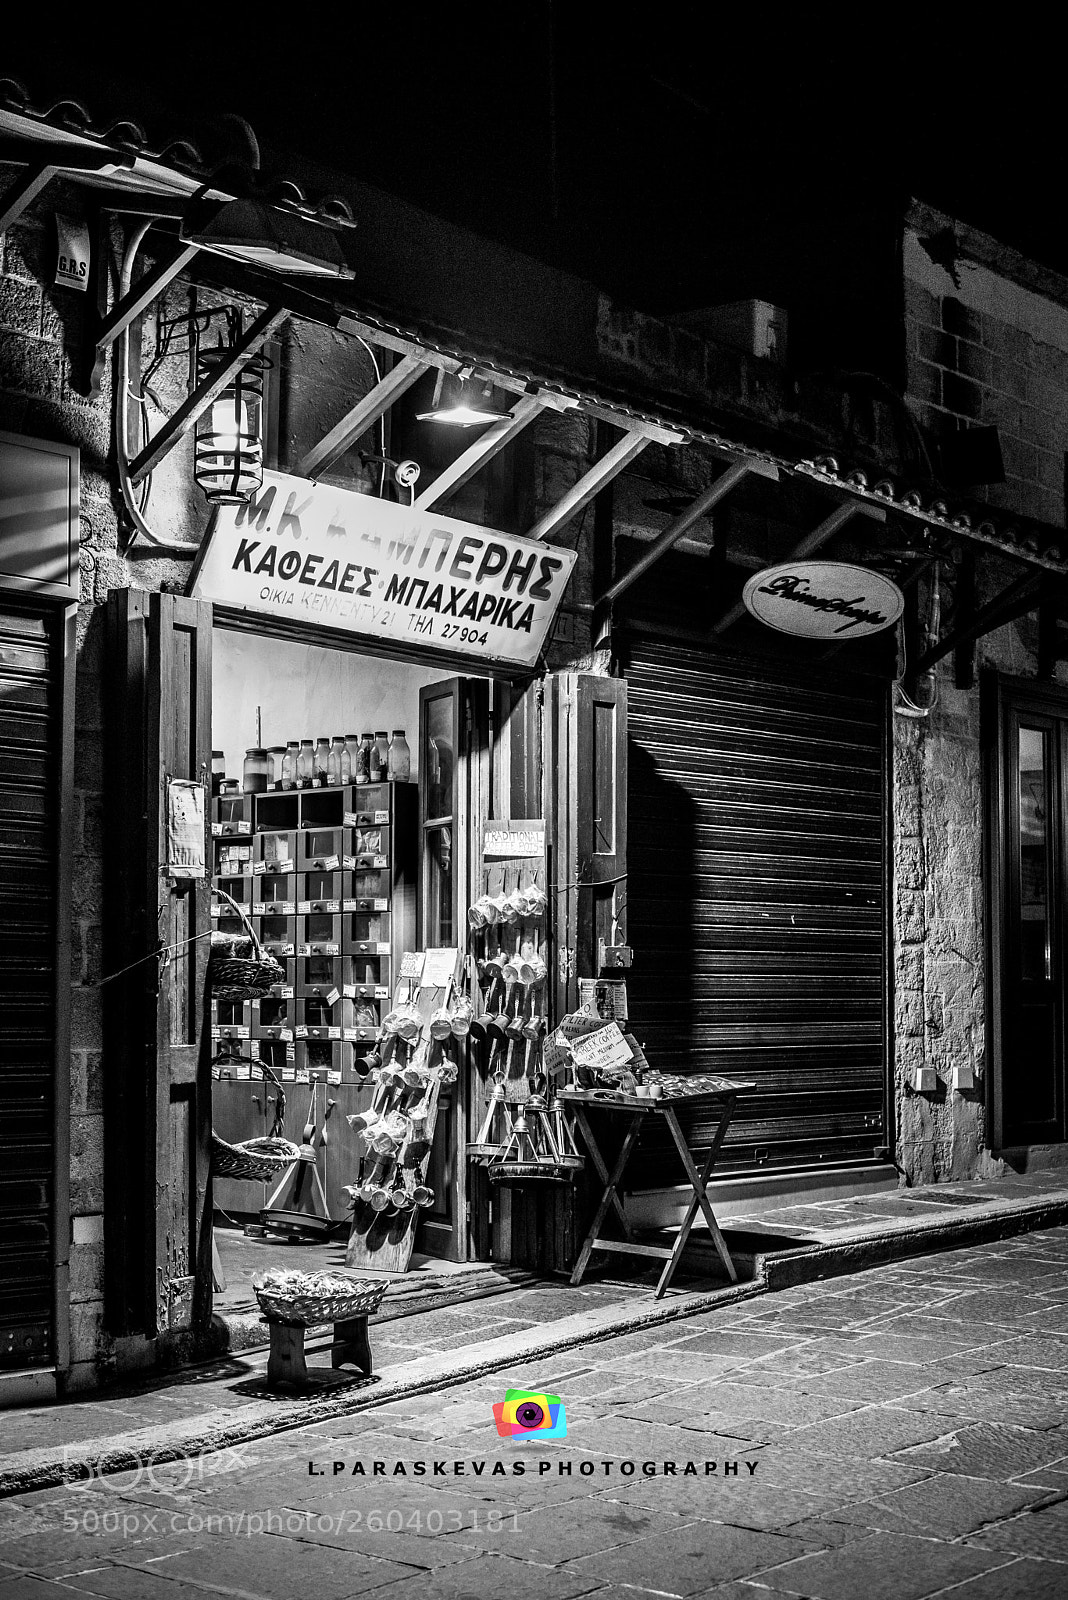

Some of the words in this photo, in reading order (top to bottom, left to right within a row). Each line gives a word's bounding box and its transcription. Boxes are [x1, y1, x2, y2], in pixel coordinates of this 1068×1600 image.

[259, 586, 294, 606] ΟΙΚΙΑ
[440, 623, 489, 647] 27904
[383, 573, 537, 634] ΜΠΑΧΑΡΙΚΑ
